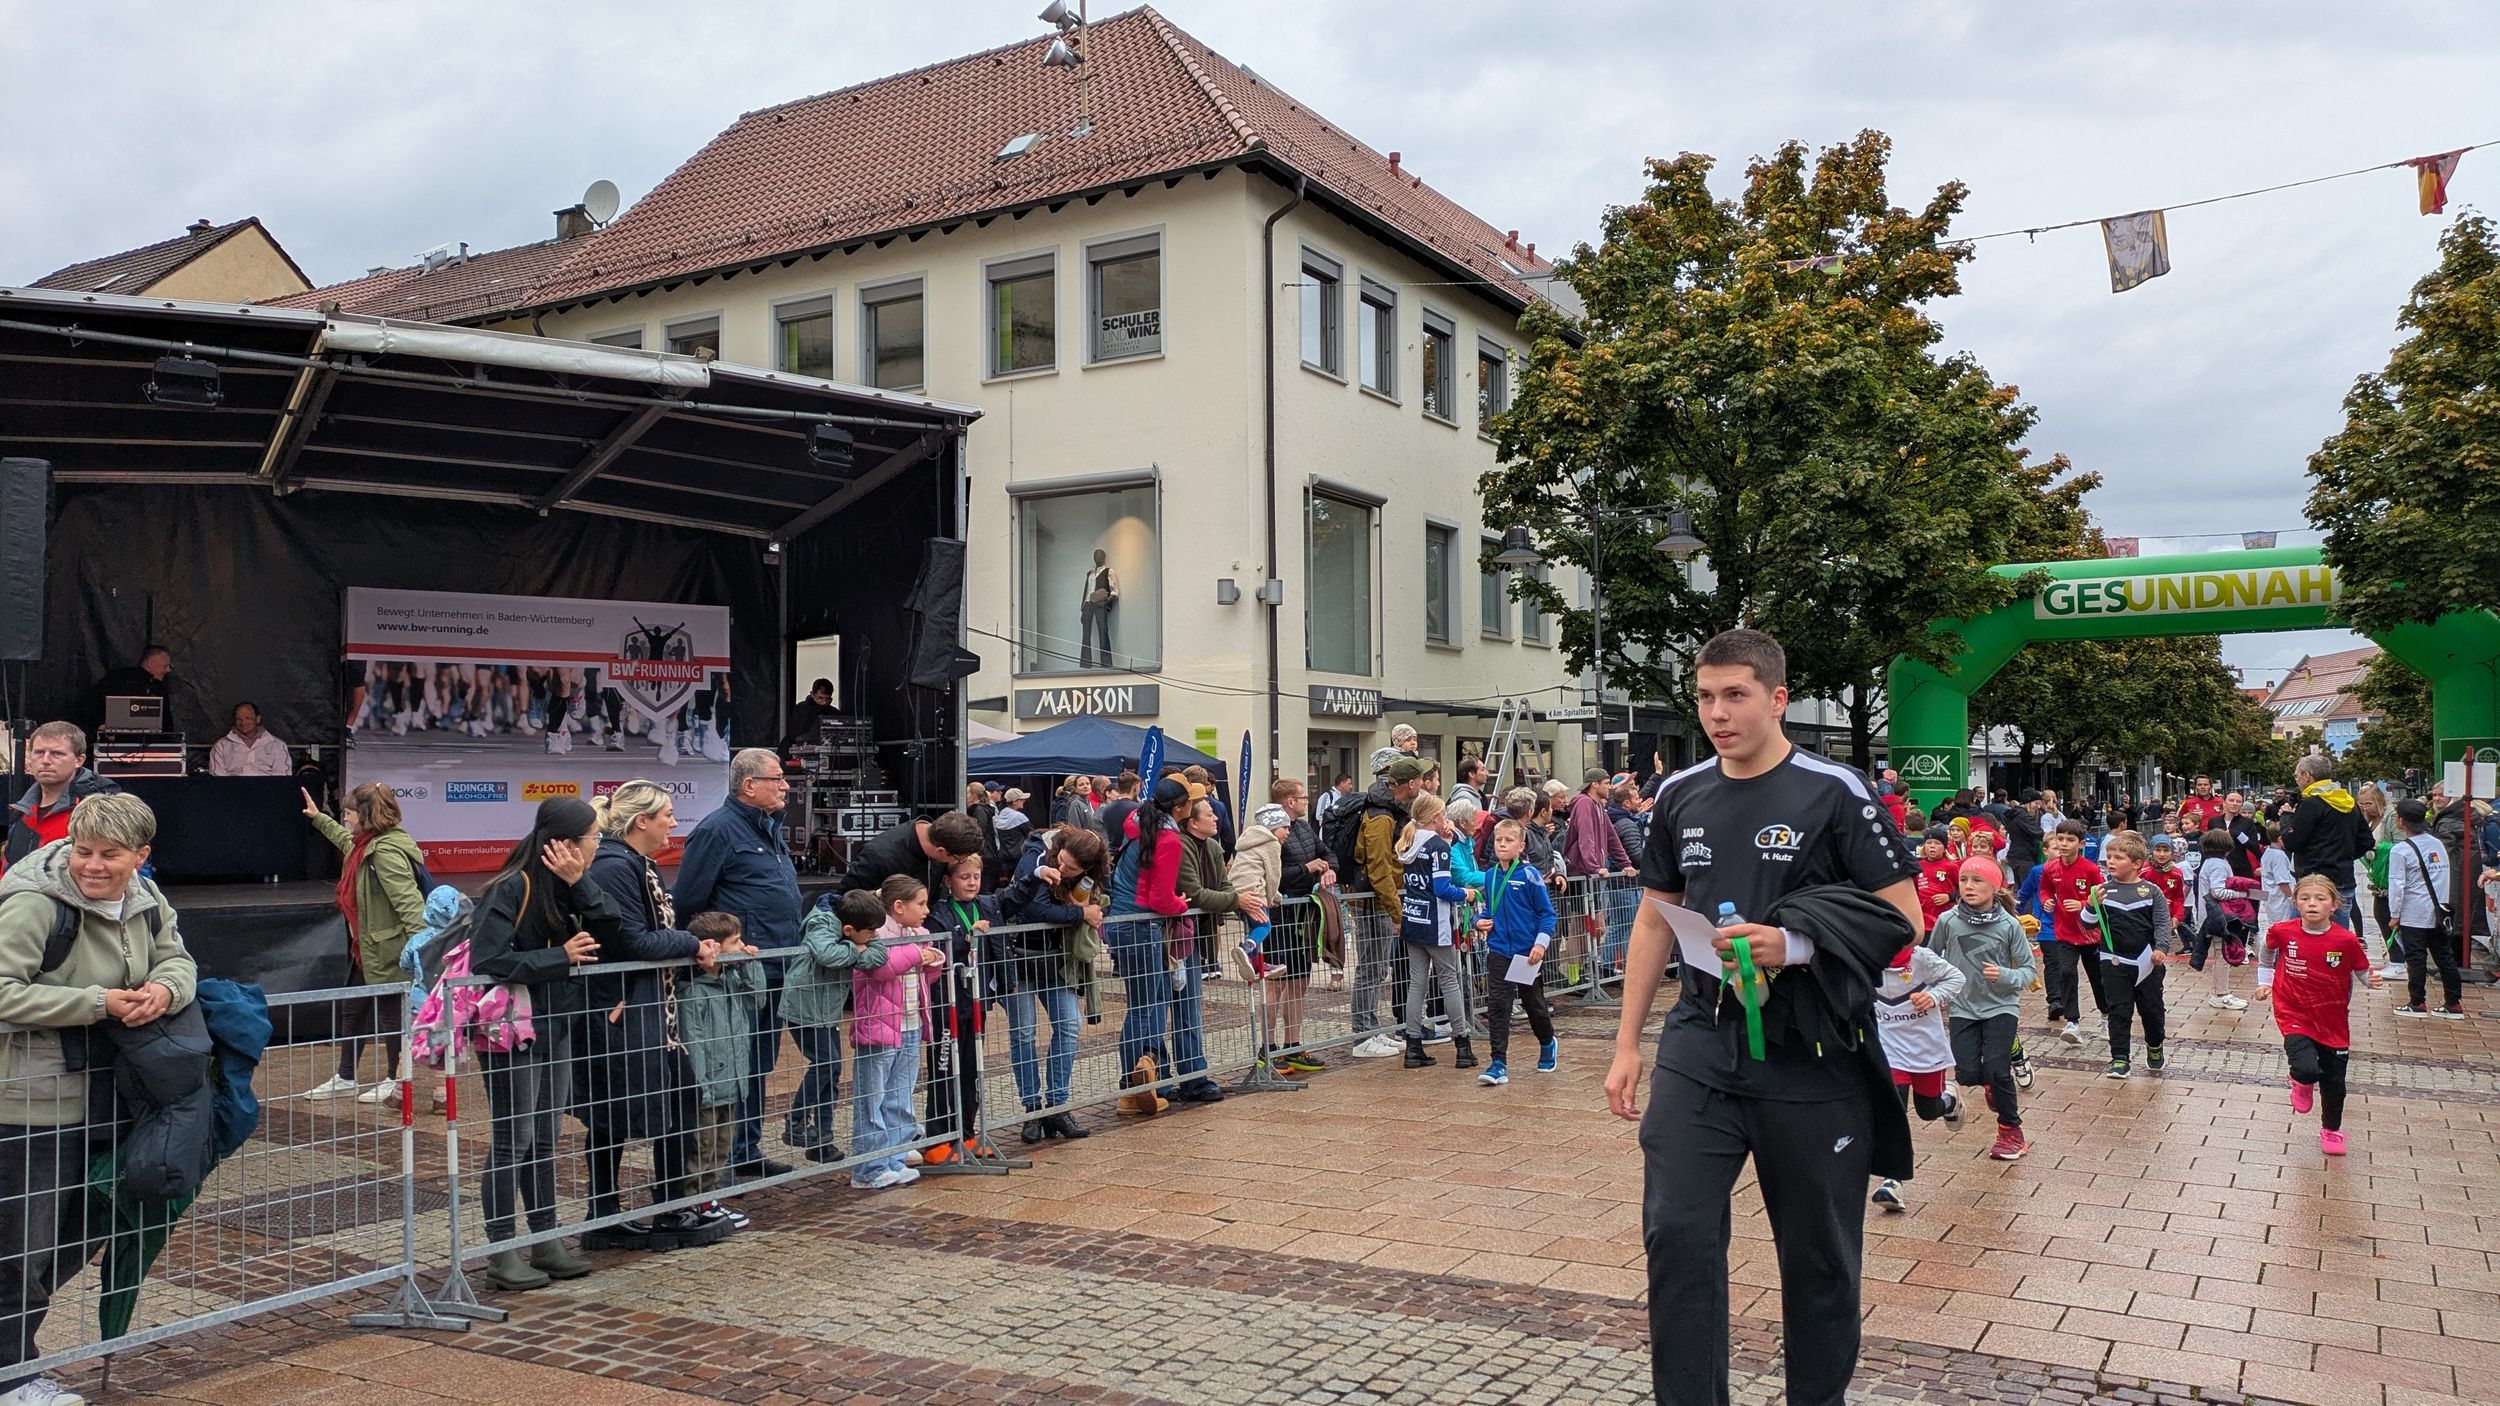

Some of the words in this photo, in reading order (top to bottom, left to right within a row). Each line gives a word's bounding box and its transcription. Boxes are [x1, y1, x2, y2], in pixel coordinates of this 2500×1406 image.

[1103, 311, 1160, 331] SCHULER
[377, 607, 414, 619] Bewegt
[417, 609, 483, 620] Unternehmen
[486, 611, 495, 620] in
[498, 613, 594, 627] Baden-Württemberg!
[377, 622, 489, 635] www.bw-running.de
[612, 663, 701, 678] BW-RUNNING
[1564, 708, 1594, 718] Spitaltörle
[1899, 754, 1951, 775] AOK
[448, 783, 495, 793] ERDINGER
[541, 784, 577, 794] LOTTO
[1682, 827, 1704, 839] JAKO
[1769, 829, 1805, 847] TSV
[438, 847, 451, 855] Die
[454, 847, 511, 855] Firmenlaufserie
[1772, 853, 1794, 862] Kutz
